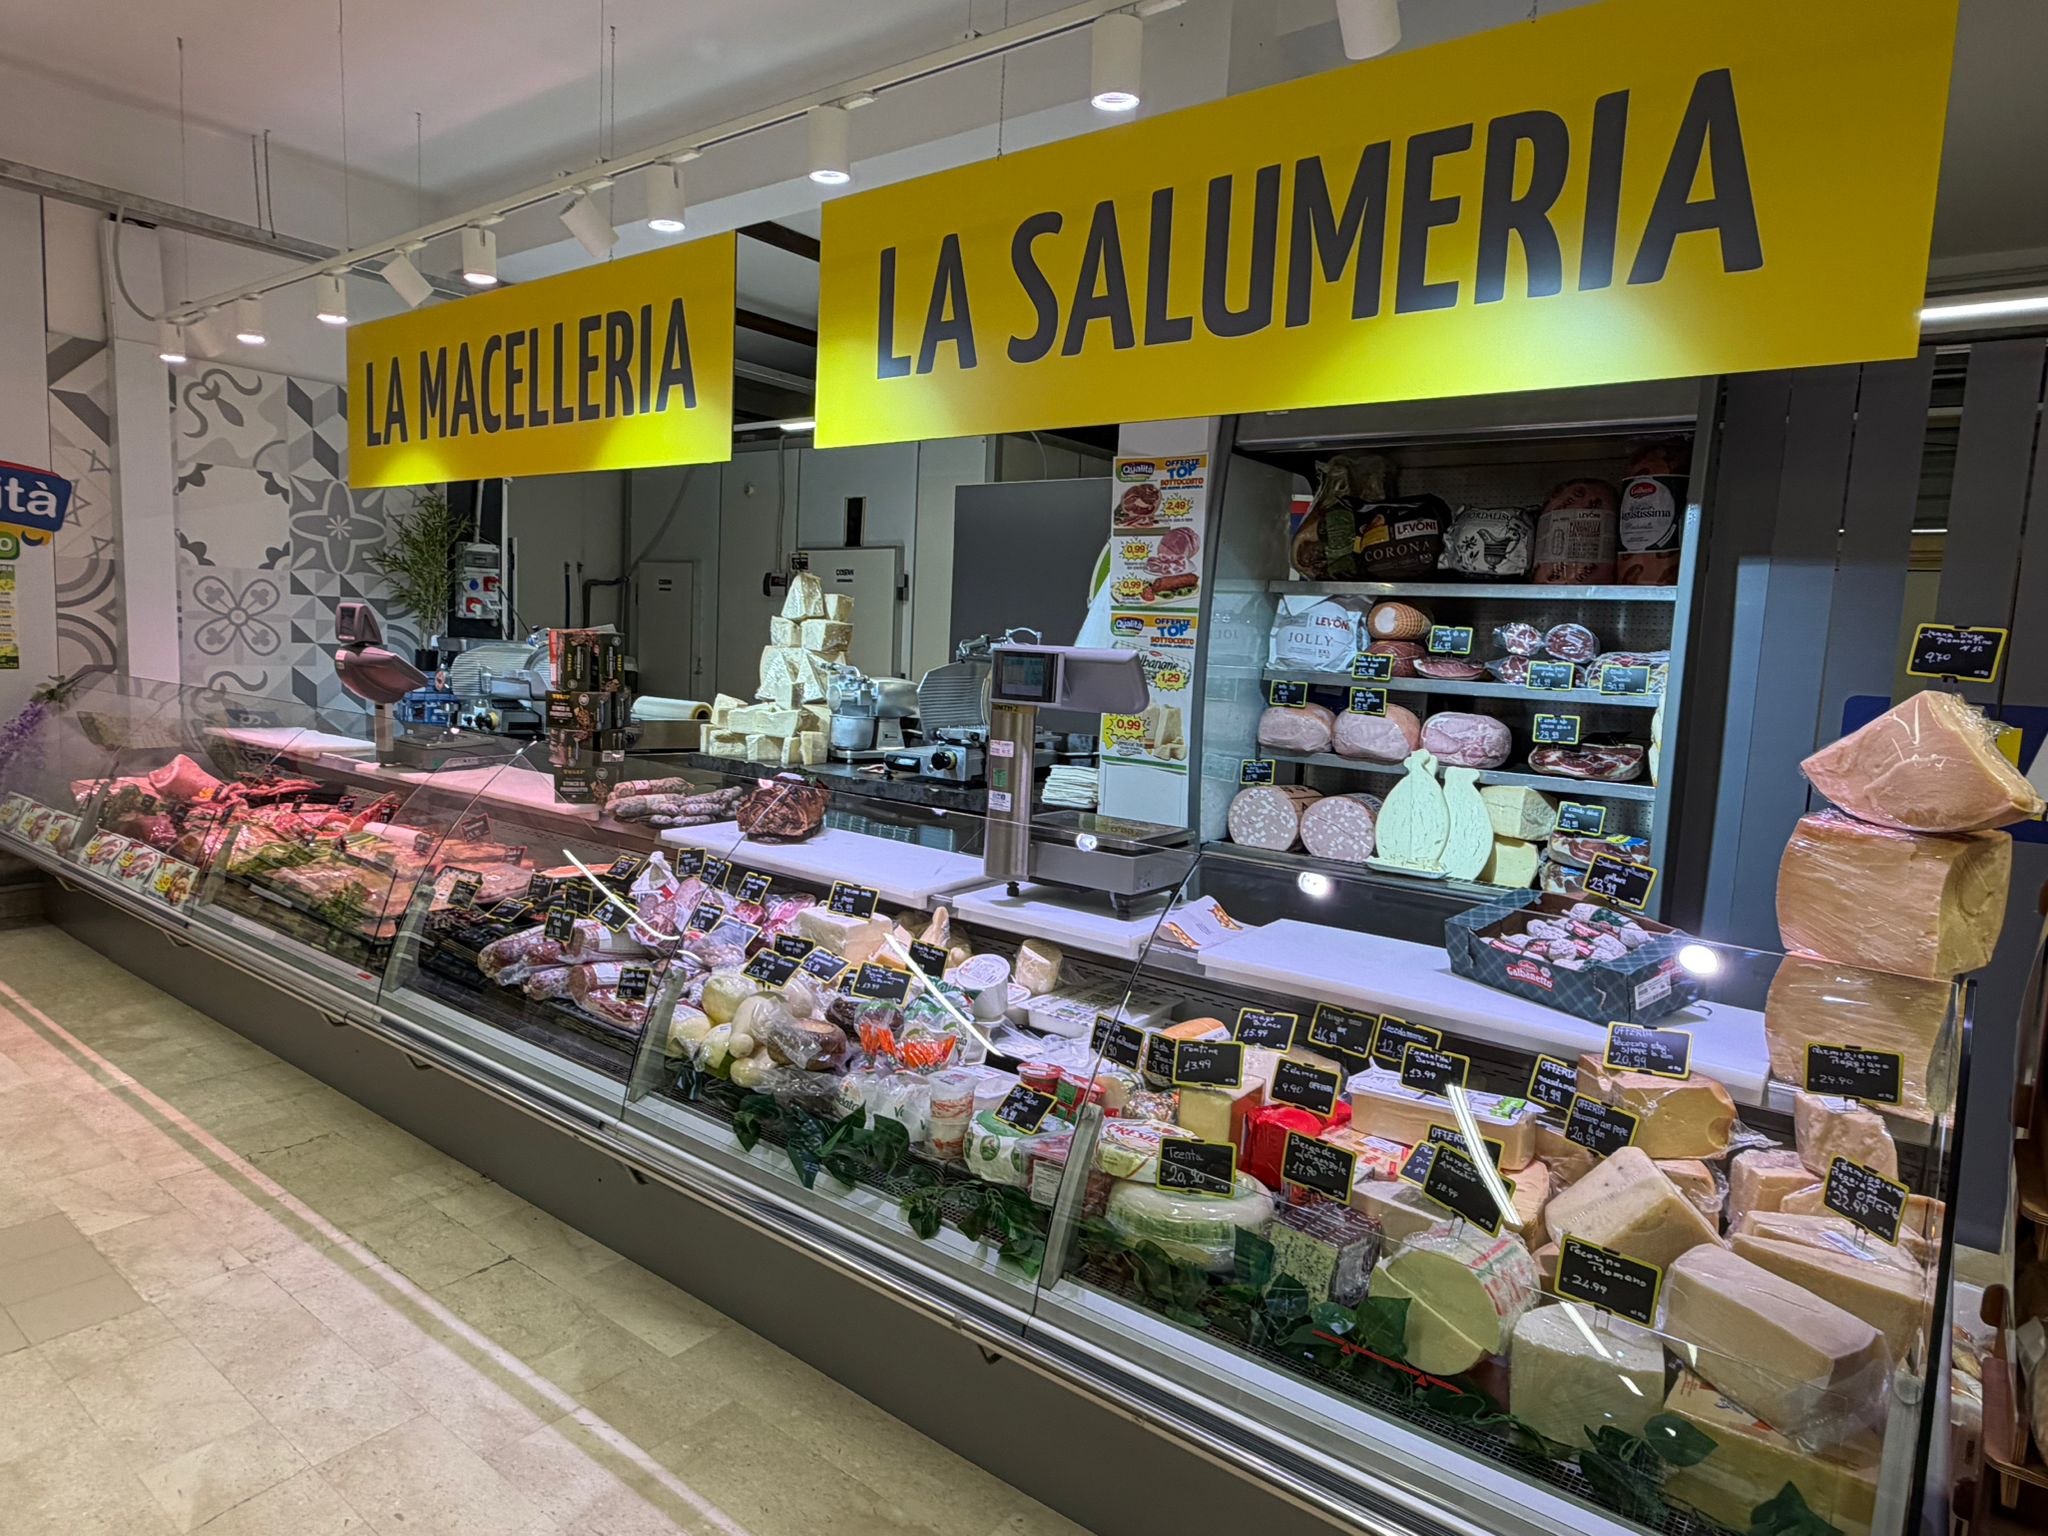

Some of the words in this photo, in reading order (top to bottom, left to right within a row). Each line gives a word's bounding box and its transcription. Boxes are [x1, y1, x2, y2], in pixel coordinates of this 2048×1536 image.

[876, 230, 978, 380] LA
[1006, 67, 1763, 364] SALUMERIA
[366, 356, 408, 447] LA
[420, 299, 697, 440] MACELLERIA
[1167, 464, 1198, 479] TOP
[1167, 501, 1186, 511] 2,49
[1126, 545, 1146, 556] 0,99
[1364, 540, 1431, 563] CORONA
[1121, 580, 1142, 591] 0,99
[1157, 624, 1189, 637] TOP
[1288, 632, 1334, 647] JOLLY
[1161, 673, 1181, 684] 1,29
[1116, 719, 1141, 732] 0,99
[1587, 1260, 1647, 1288] Romano
